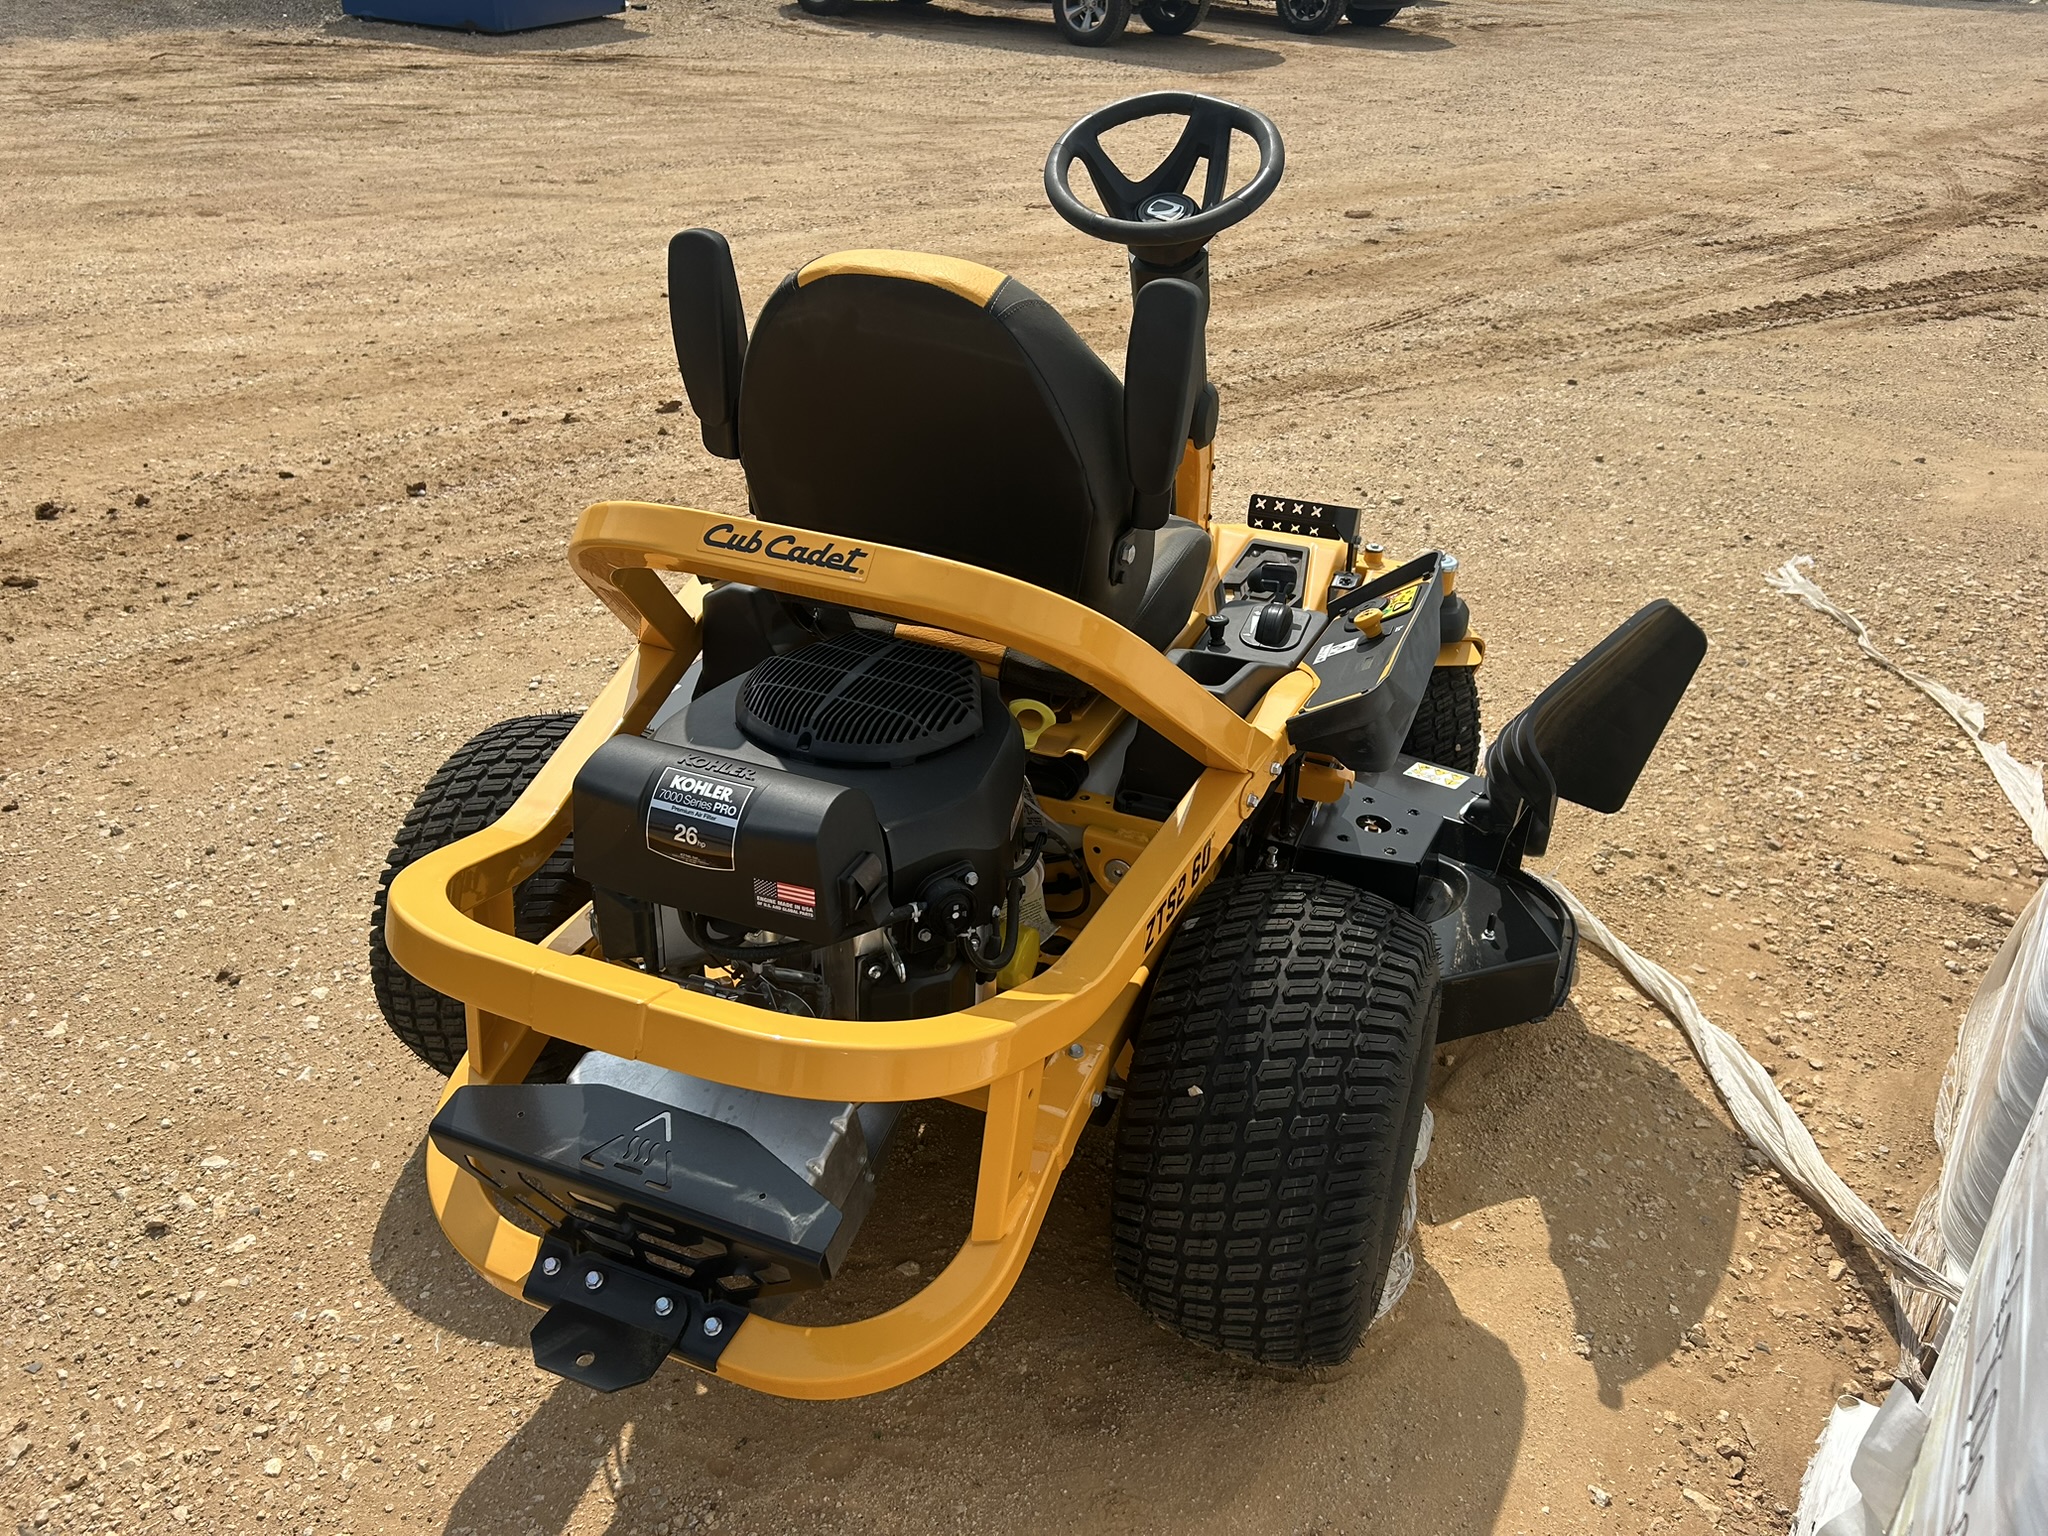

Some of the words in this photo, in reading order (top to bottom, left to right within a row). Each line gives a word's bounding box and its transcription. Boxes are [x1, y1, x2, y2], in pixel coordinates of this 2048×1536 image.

[703, 523, 763, 554] Cub
[764, 535, 869, 574] Cadet
[658, 788, 684, 803] 7000
[683, 793, 713, 811] Series
[712, 803, 738, 816] PRO
[670, 804, 695, 816] Premium
[694, 810, 703, 818] Air
[702, 812, 718, 822] Filter
[673, 823, 698, 845] 26
[756, 895, 777, 905] ENGINE
[777, 900, 794, 909] MADE
[1144, 872, 1187, 954] ZTS2
[1191, 838, 1212, 888] 60
[782, 906, 799, 915] GLOBAL
[799, 910, 814, 918] PARTS
